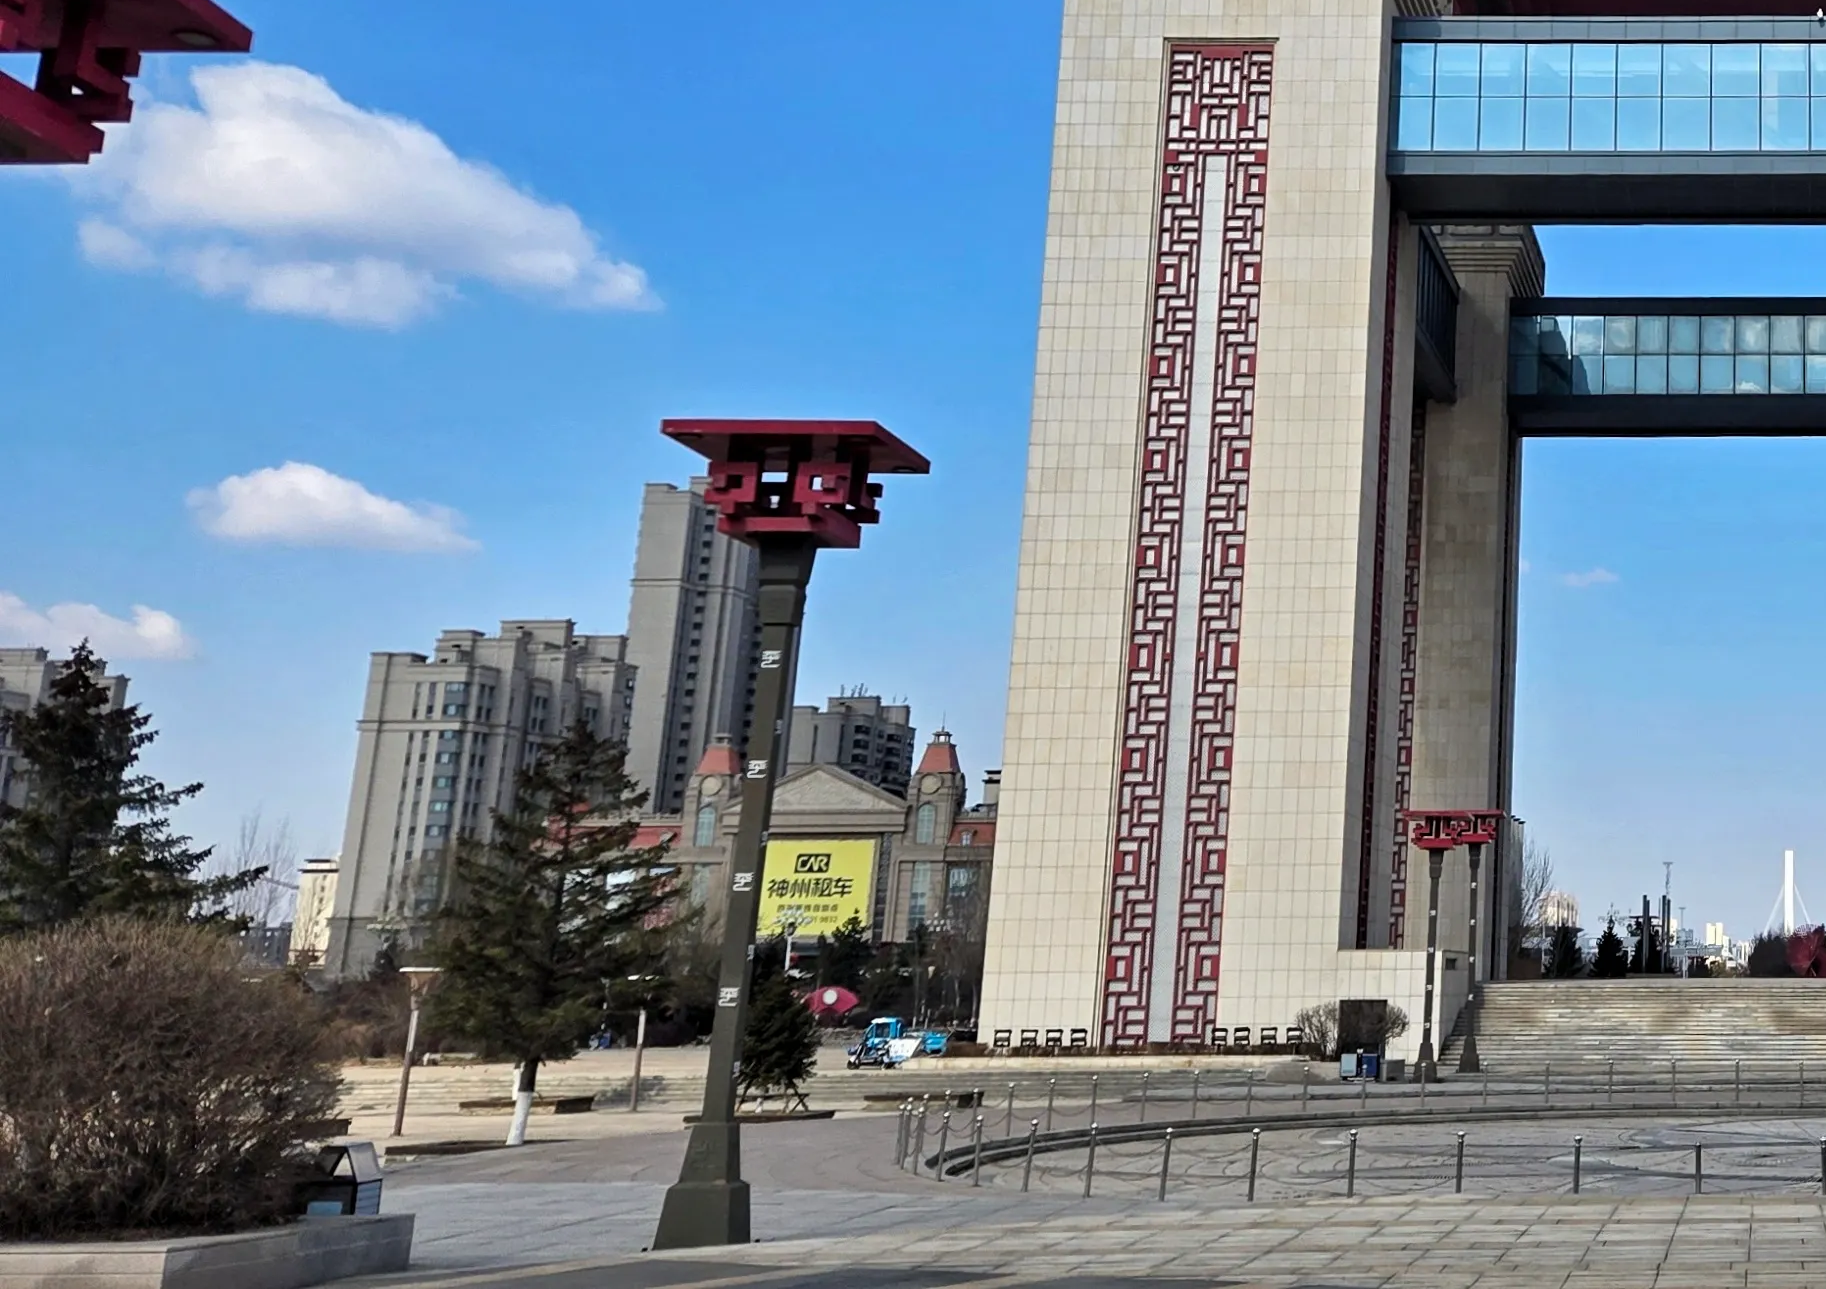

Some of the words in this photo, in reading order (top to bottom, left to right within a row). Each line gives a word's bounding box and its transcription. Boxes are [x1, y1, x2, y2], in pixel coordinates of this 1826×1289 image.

[796, 855, 829, 872] CAR
[767, 877, 854, 899] 神州租车
